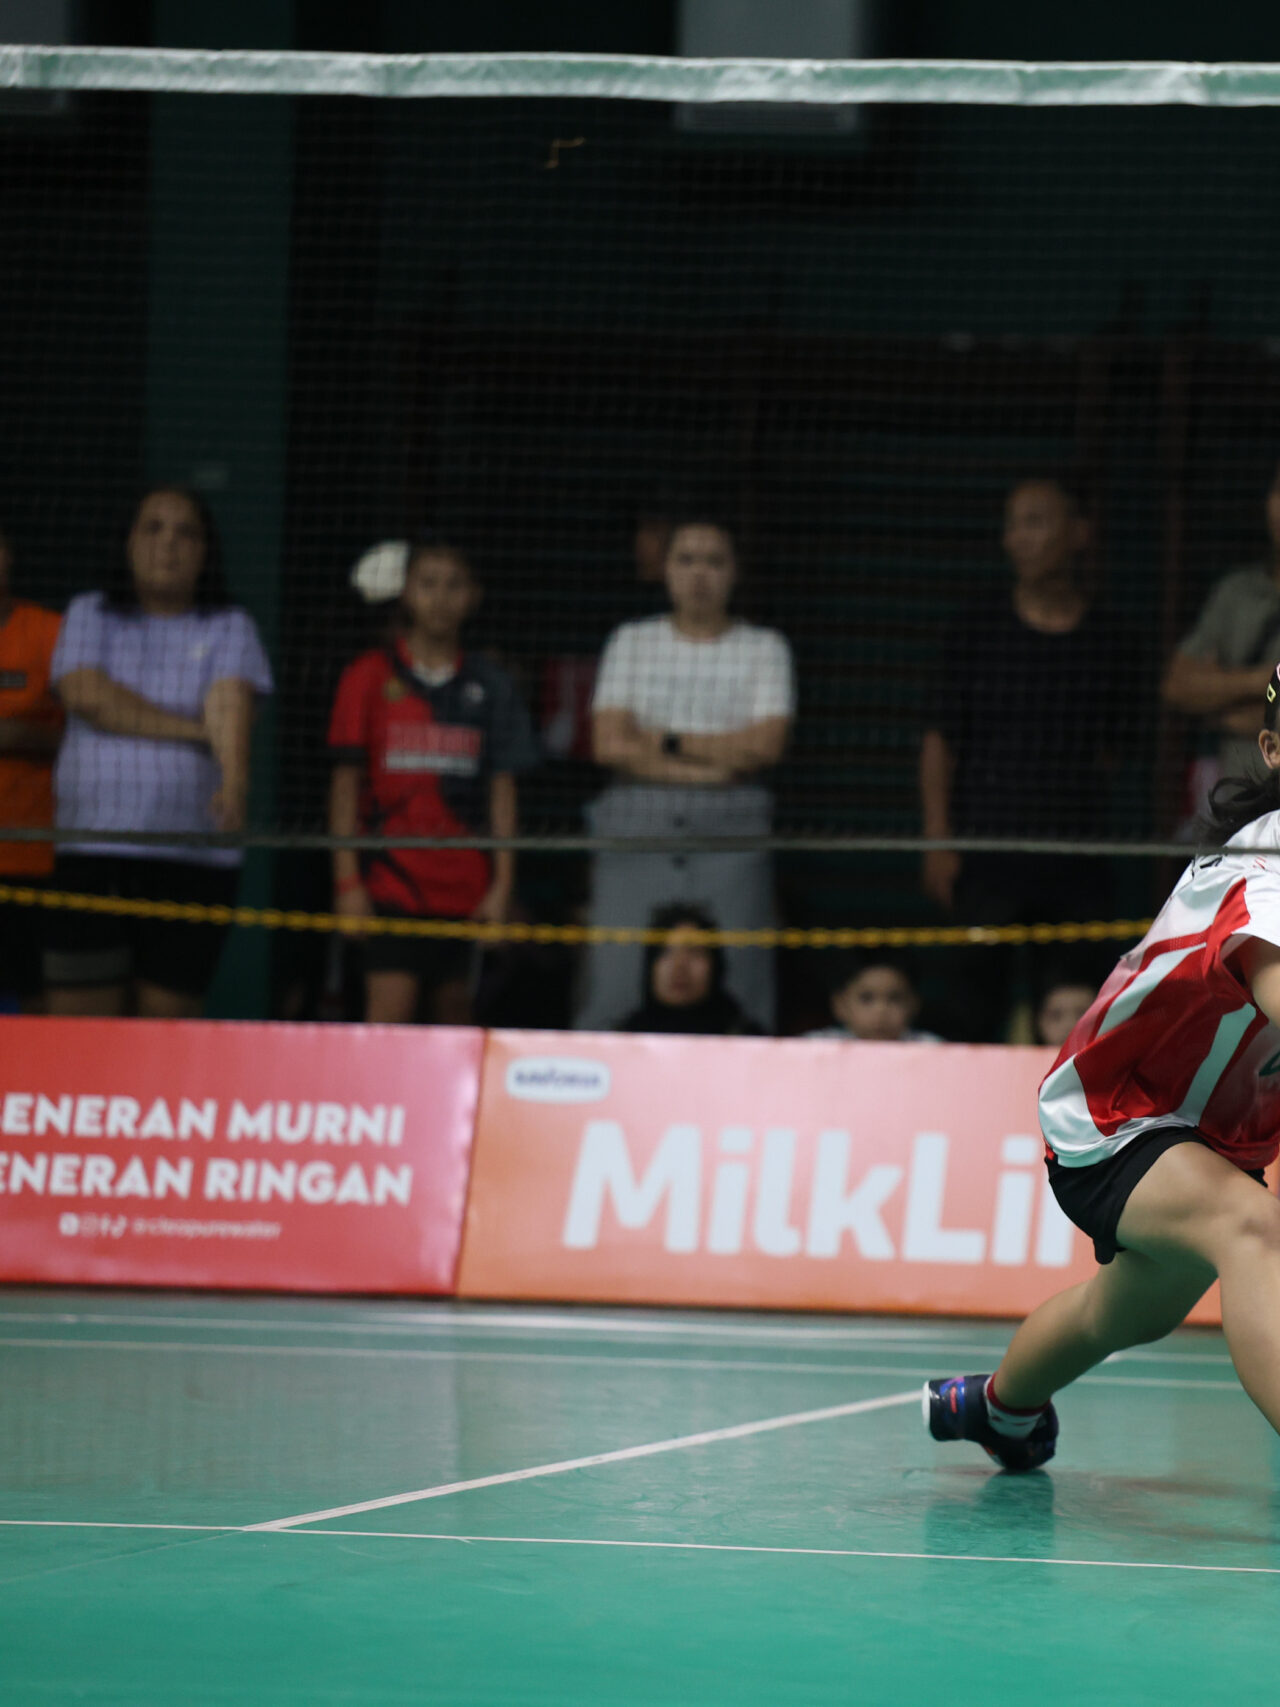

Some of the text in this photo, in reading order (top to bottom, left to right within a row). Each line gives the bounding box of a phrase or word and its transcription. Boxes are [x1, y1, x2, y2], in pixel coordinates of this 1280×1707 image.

[1, 1092, 406, 1148] ENERAN MURNI
[204, 1157, 413, 1207] RINGAN
